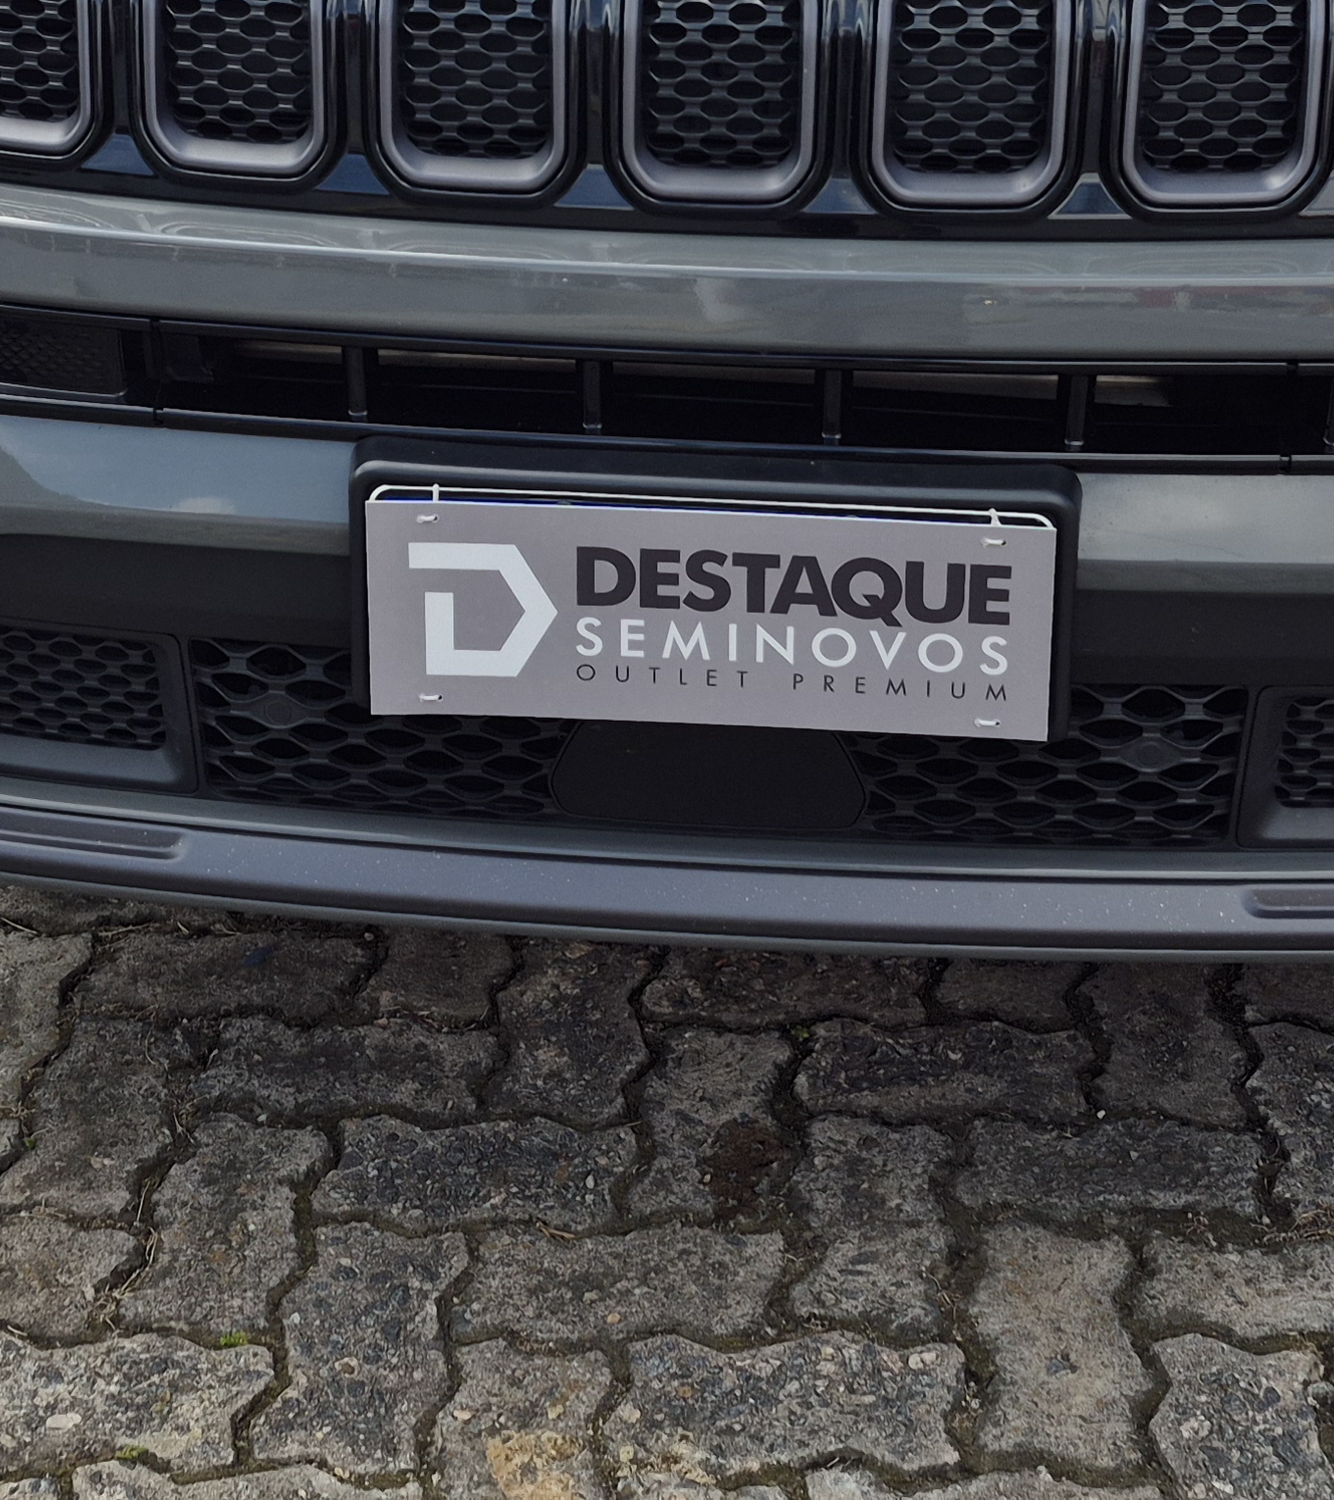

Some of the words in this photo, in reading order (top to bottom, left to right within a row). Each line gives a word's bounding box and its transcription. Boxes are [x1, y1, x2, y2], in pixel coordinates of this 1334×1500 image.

[575, 545, 1013, 628] DESTAQUE
[575, 616, 1010, 677] SEMINOVOS
[575, 663, 750, 690] OUTLET
[793, 672, 1009, 702] PREMIUM
